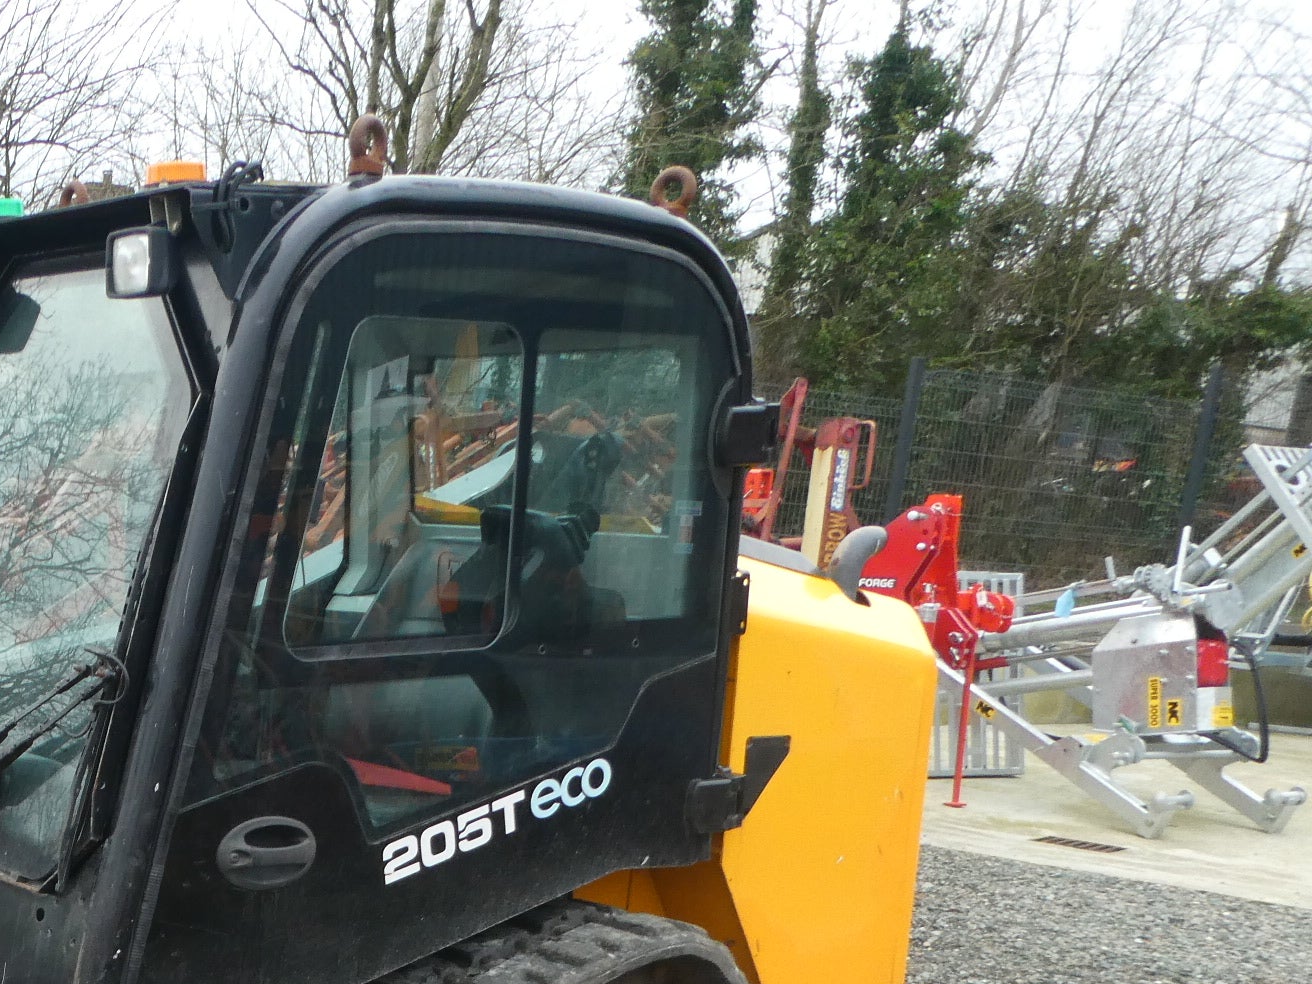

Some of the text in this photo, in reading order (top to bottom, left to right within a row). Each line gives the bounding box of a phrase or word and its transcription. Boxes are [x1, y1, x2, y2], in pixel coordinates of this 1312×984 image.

[858, 577, 897, 589] FORGE
[1168, 701, 1180, 724] NC
[382, 757, 612, 886] 205T eco
